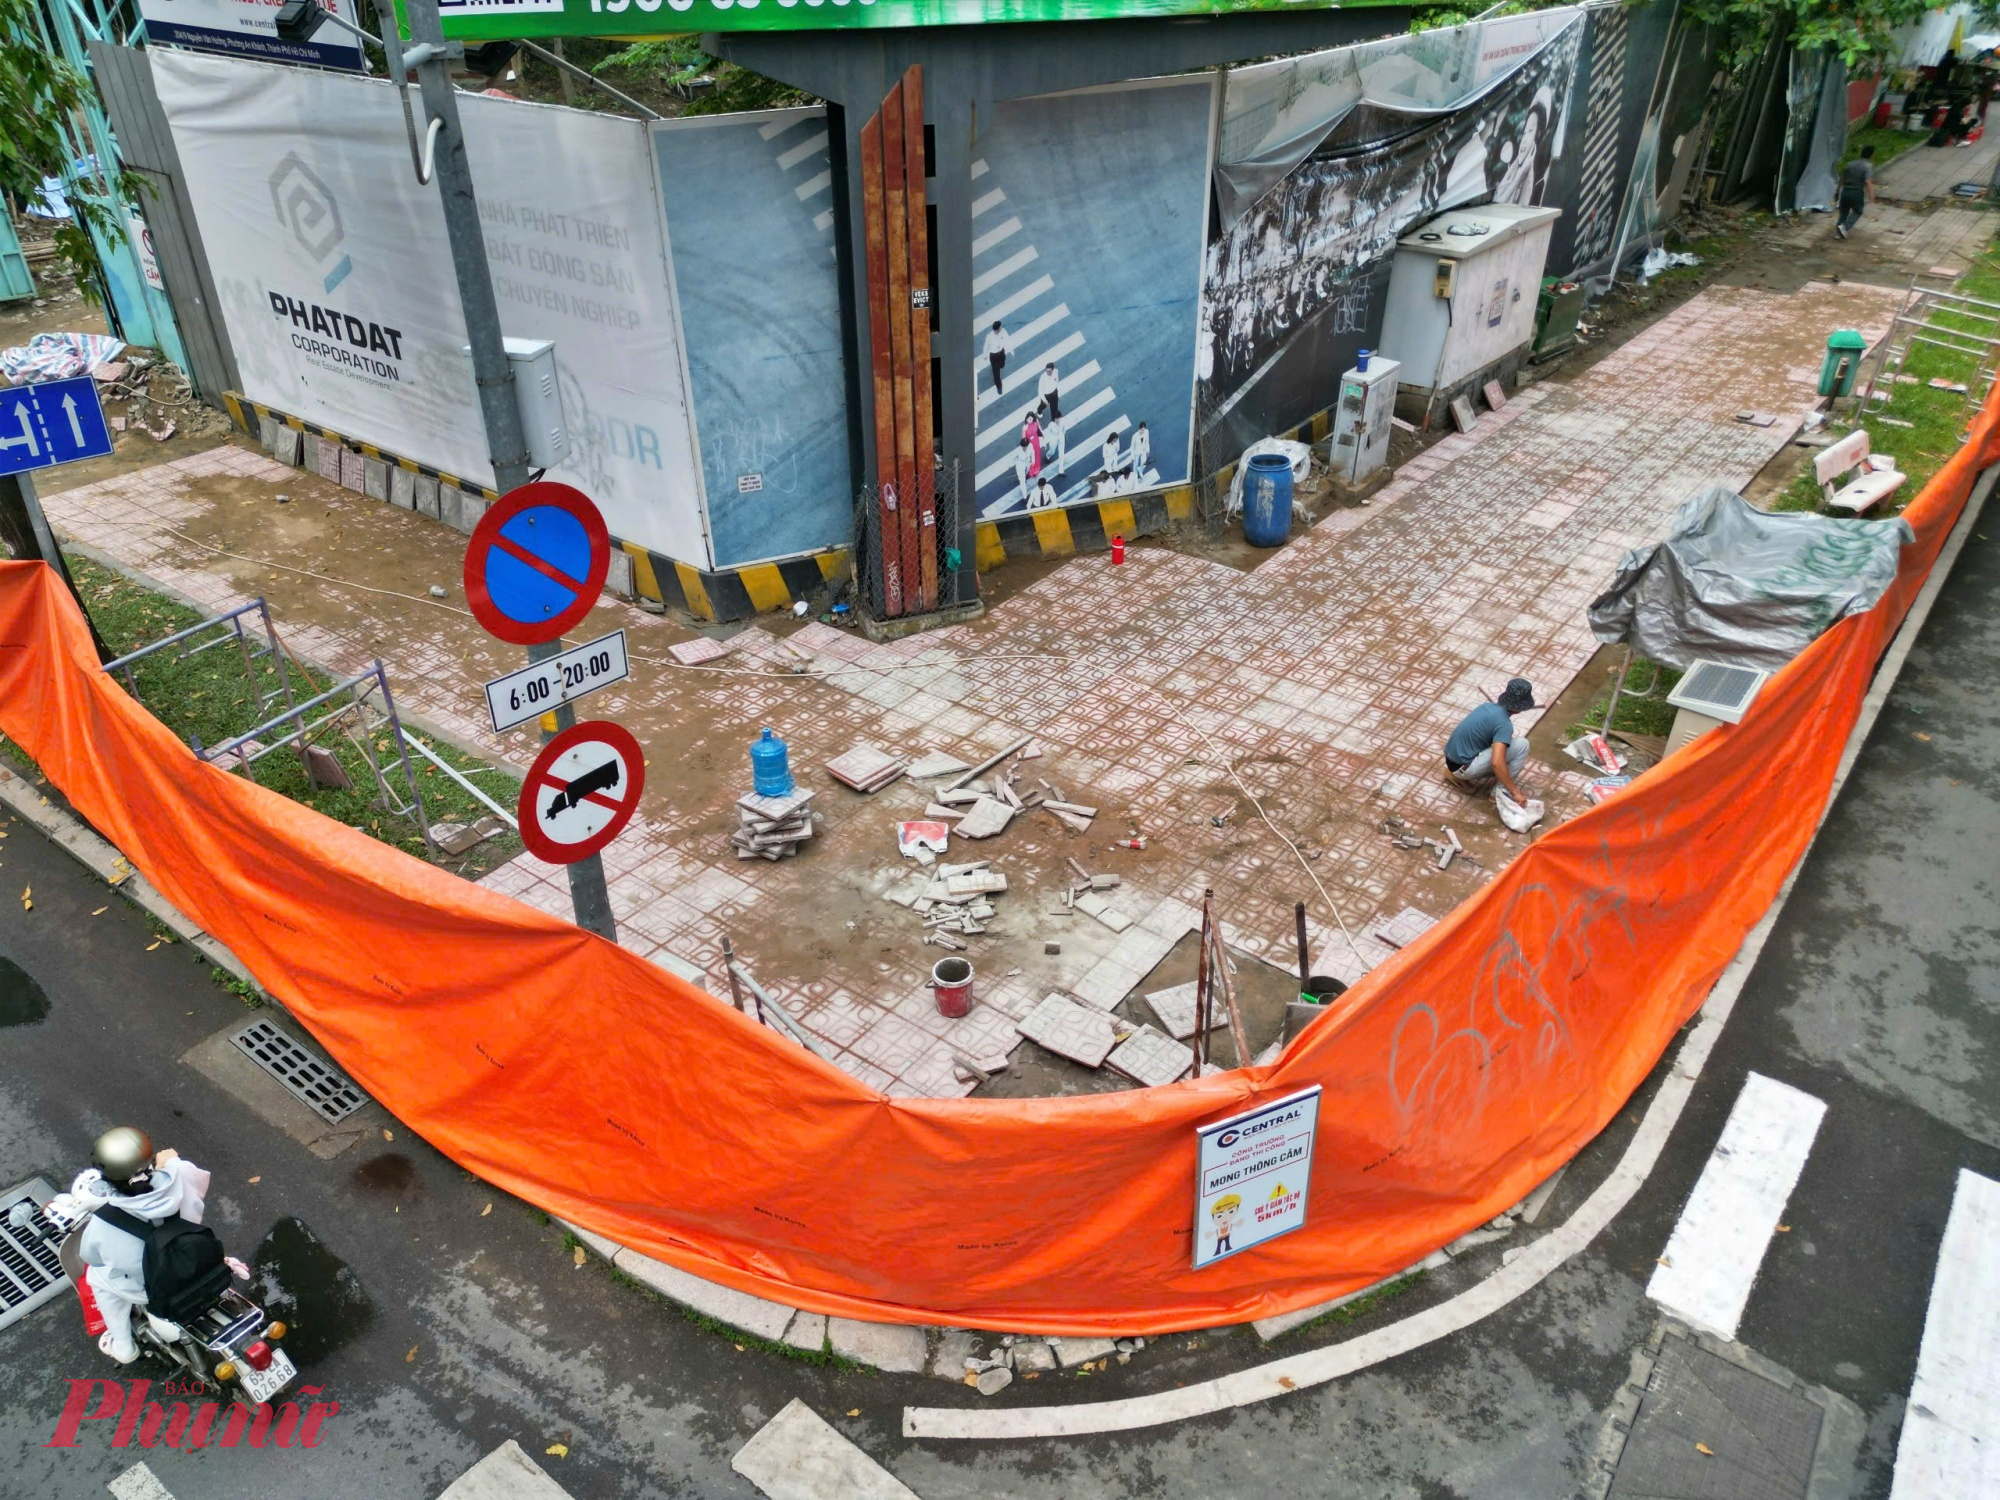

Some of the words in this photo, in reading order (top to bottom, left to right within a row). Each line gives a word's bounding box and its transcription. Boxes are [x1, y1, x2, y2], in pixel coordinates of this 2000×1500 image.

[574, 214, 631, 251] TRIỂN
[589, 258, 635, 294] SẢN
[268, 291, 402, 360] PHATDAT
[291, 333, 400, 381] CORPORATION
[322, 360, 345, 376] Estate
[345, 367, 393, 392] Development
[1241, 1109, 1302, 1137] CENTRAL
[1229, 1154, 1251, 1166] ĐANG
[1251, 1147, 1265, 1157] THI
[1264, 1140, 1287, 1153] CÔNG
[1231, 1146, 1254, 1158] CÔNG
[1255, 1134, 1286, 1150] TRƯỜNG
[1209, 1169, 1241, 1189] MONG
[1243, 1155, 1278, 1177] THÔNG
[1279, 1146, 1303, 1162] CẢM
[253, 1364, 293, 1401] 026.68
